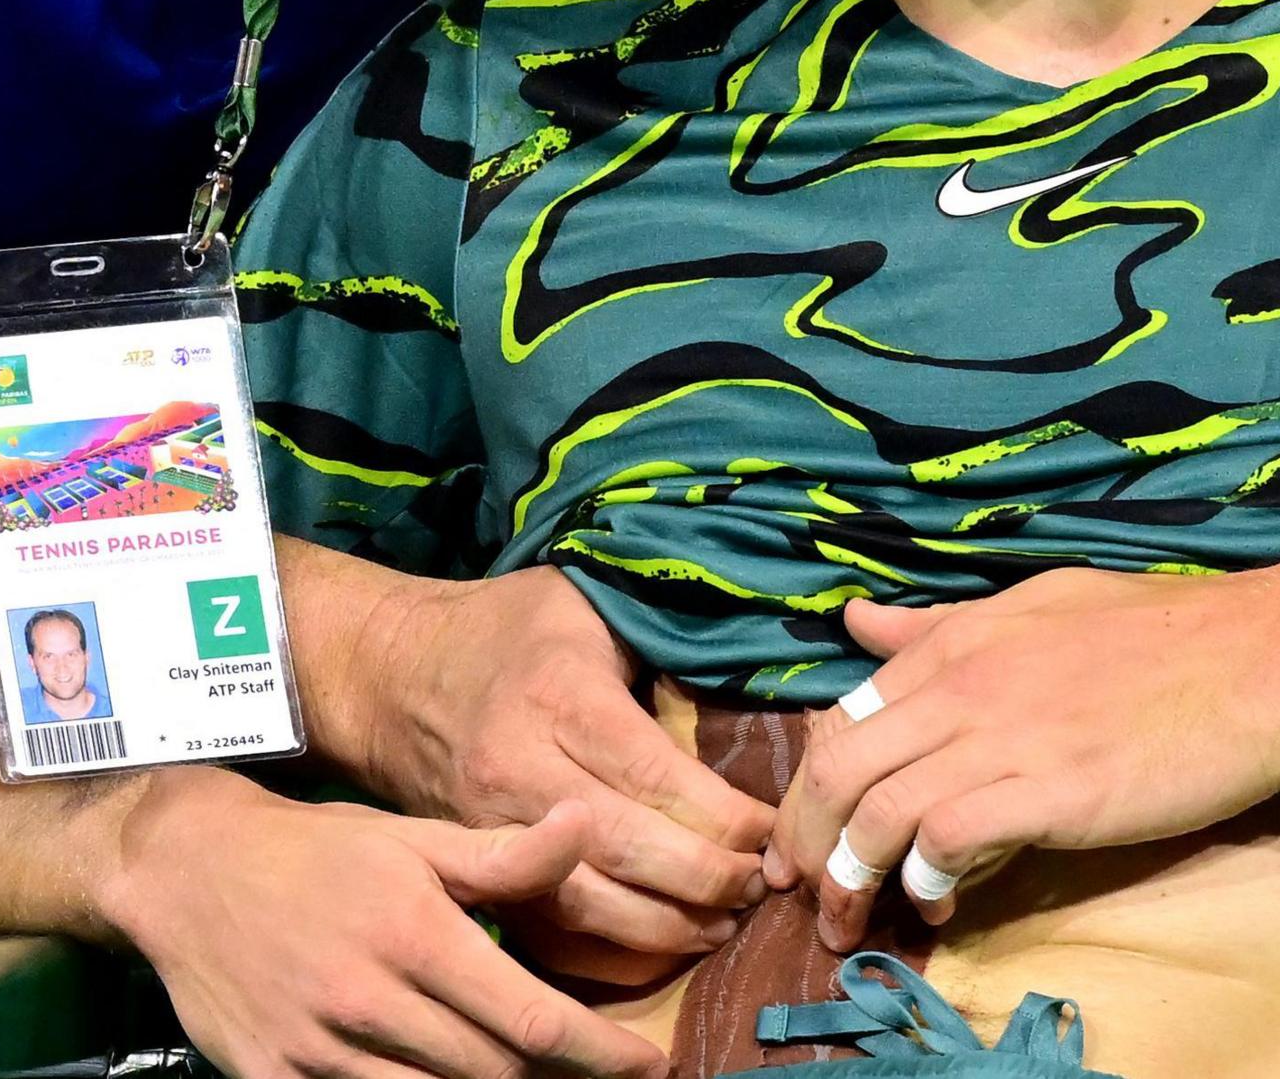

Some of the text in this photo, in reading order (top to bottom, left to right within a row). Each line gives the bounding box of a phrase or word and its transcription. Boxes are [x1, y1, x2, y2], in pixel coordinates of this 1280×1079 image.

[15, 539, 99, 561] TENNIS
[107, 528, 222, 553] PARADISE
[210, 595, 247, 637] Z
[169, 661, 272, 680] Clay Sniteman
[208, 679, 275, 697] ATP Staff
[186, 740, 203, 751] 23
